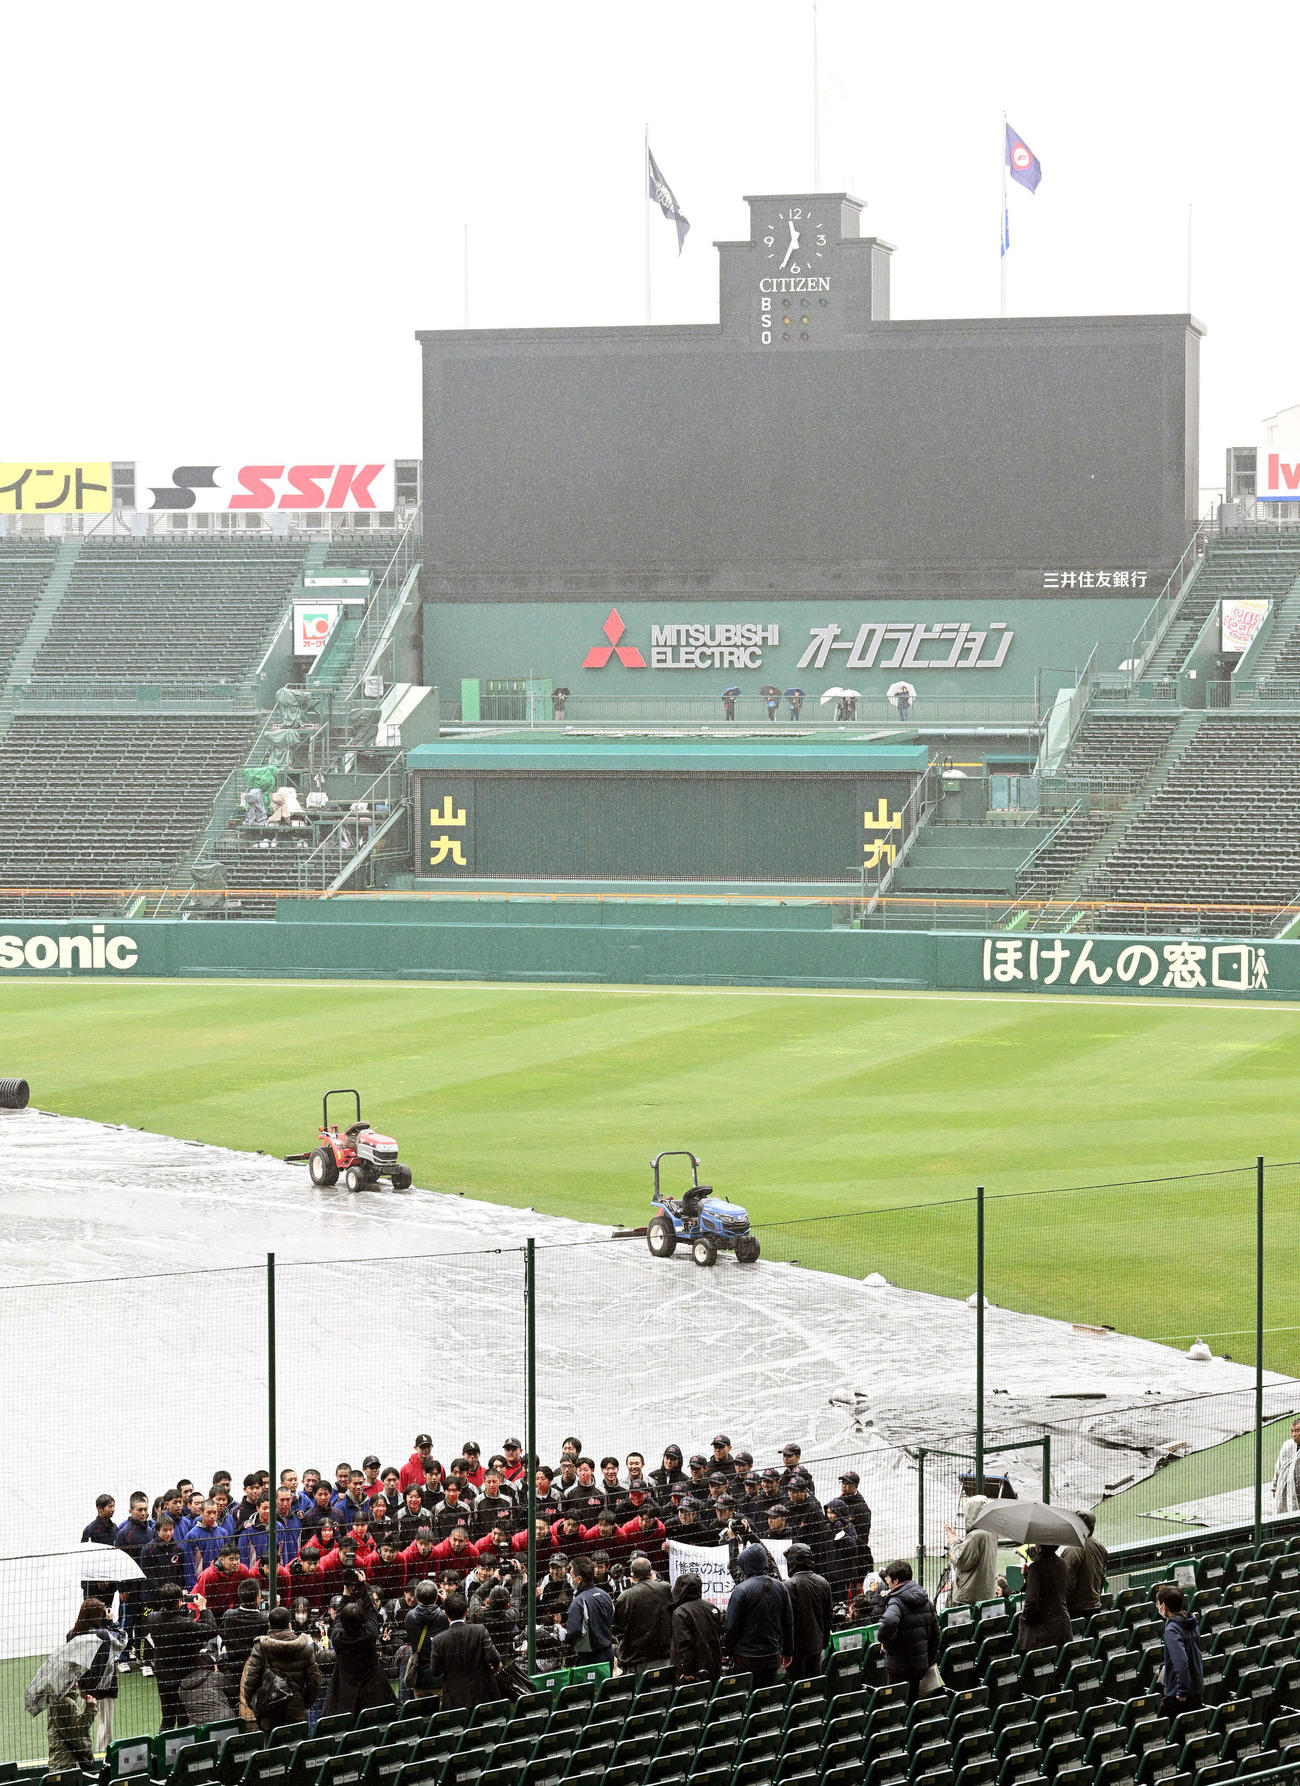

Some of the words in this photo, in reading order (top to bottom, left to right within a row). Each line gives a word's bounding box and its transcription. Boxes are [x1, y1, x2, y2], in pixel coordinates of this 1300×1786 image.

[790, 208, 801, 219] 12
[764, 236, 774, 247] 9
[817, 234, 826, 245] 3
[791, 263, 800, 273] 6
[760, 277, 830, 292] CITIZEN
[761, 298, 771, 311] B
[761, 314, 771, 328] S
[228, 464, 386, 509] SSK
[1043, 571, 1148, 588] 三井住友銀行
[651, 624, 779, 647] MITSUBISHI
[797, 623, 1014, 668] オーロラビジョン
[651, 647, 762, 669] ELECTRIC
[430, 795, 466, 865] 山九
[863, 798, 902, 869] 山九
[0, 924, 138, 969] sonic
[983, 939, 1248, 990] ほけんの窓口
